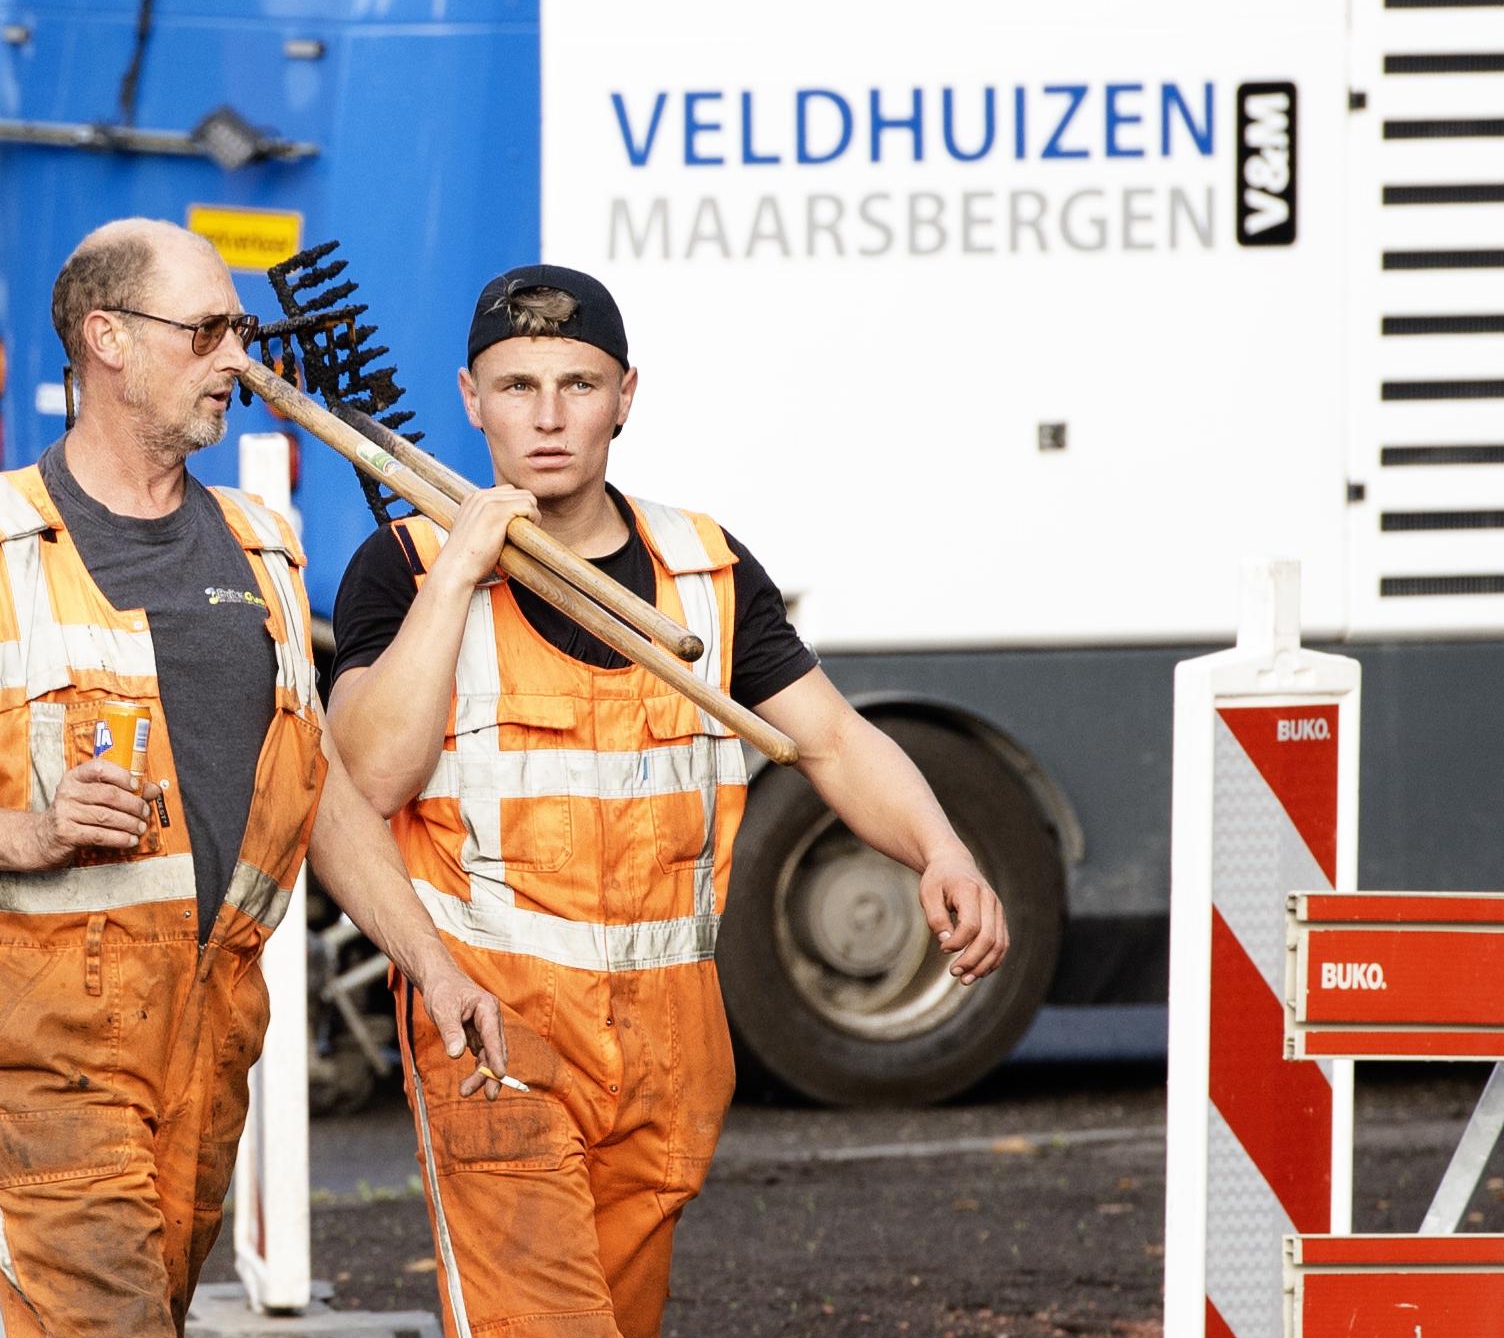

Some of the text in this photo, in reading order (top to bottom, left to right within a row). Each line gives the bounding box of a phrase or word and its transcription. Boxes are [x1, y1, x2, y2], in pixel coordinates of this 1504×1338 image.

[609, 81, 1215, 167] VELDHUIZEN
[1243, 92, 1290, 236] V&M
[607, 186, 1215, 261] MAARSBERGEN
[1277, 717, 1331, 742] BUKO.
[1321, 962, 1388, 990] BUKO.
